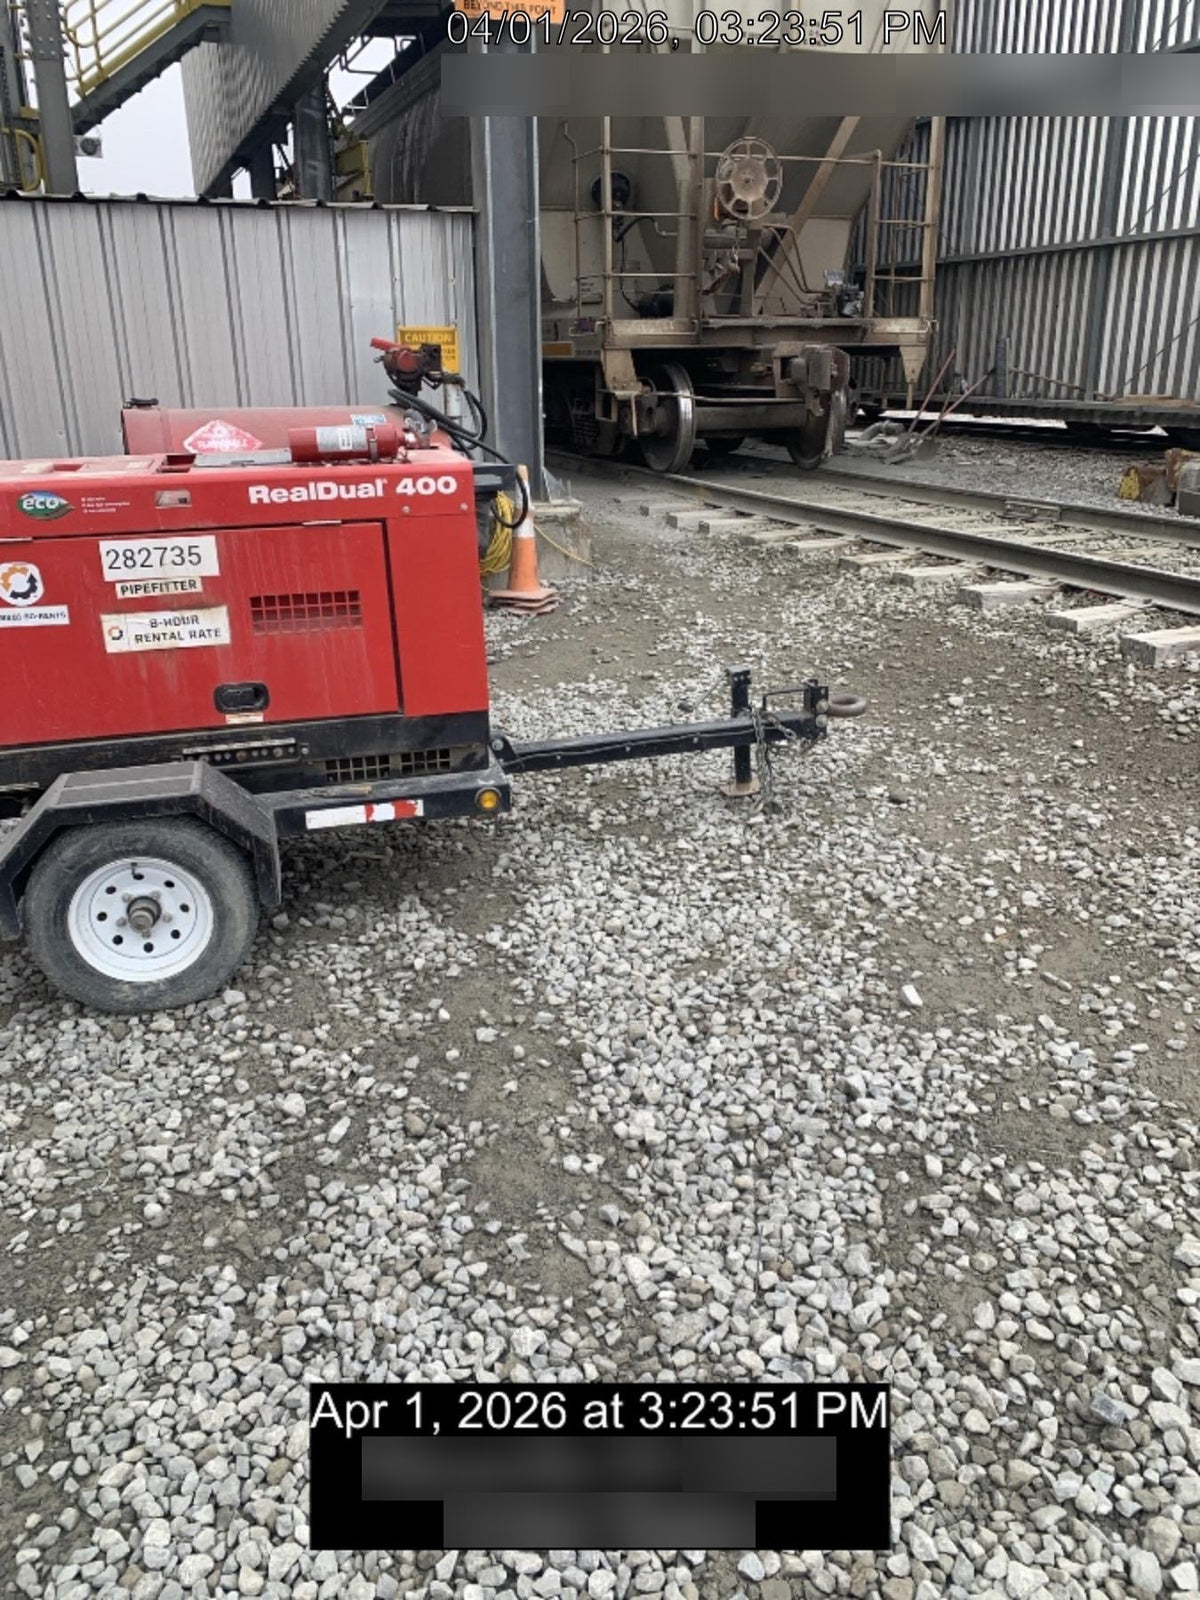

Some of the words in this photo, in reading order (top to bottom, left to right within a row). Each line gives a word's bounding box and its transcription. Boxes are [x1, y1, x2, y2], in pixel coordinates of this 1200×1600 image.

[404, 332, 453, 343] CAUTION
[248, 478, 386, 504] RealDual
[395, 476, 458, 496] 400
[22, 495, 60, 510] eco
[105, 545, 202, 570] 282735
[120, 579, 198, 596] PIPEFITTER
[149, 614, 200, 628] 8-HOUR
[134, 631, 185, 644] RENTAL
[188, 627, 222, 639] RATE
